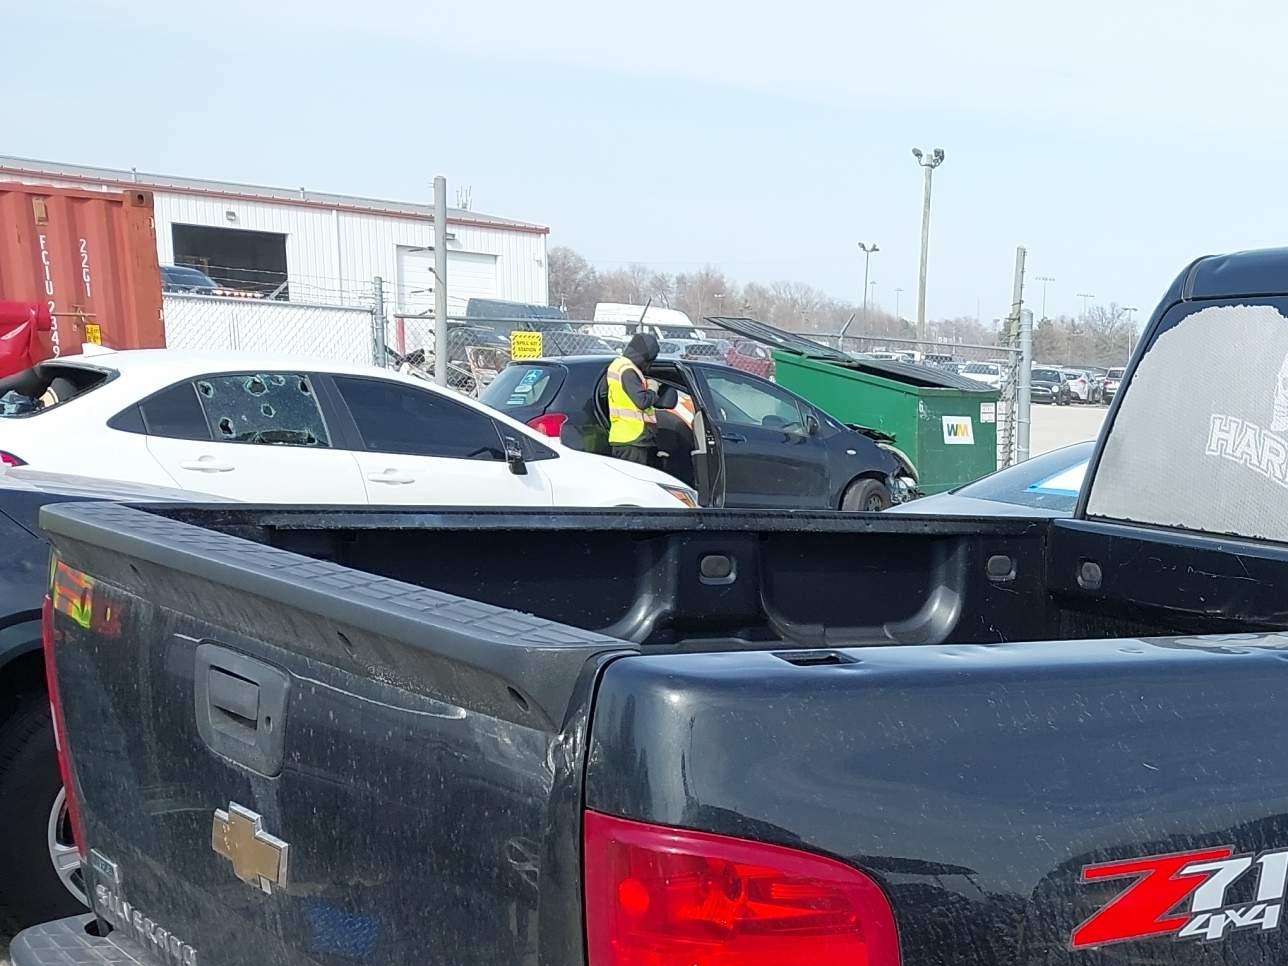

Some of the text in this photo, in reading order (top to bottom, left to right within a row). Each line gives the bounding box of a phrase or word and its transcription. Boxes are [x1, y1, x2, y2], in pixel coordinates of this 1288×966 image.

[40, 235, 54, 295] FCIU
[80, 239, 92, 297] 22G1
[946, 423, 969, 437] WM
